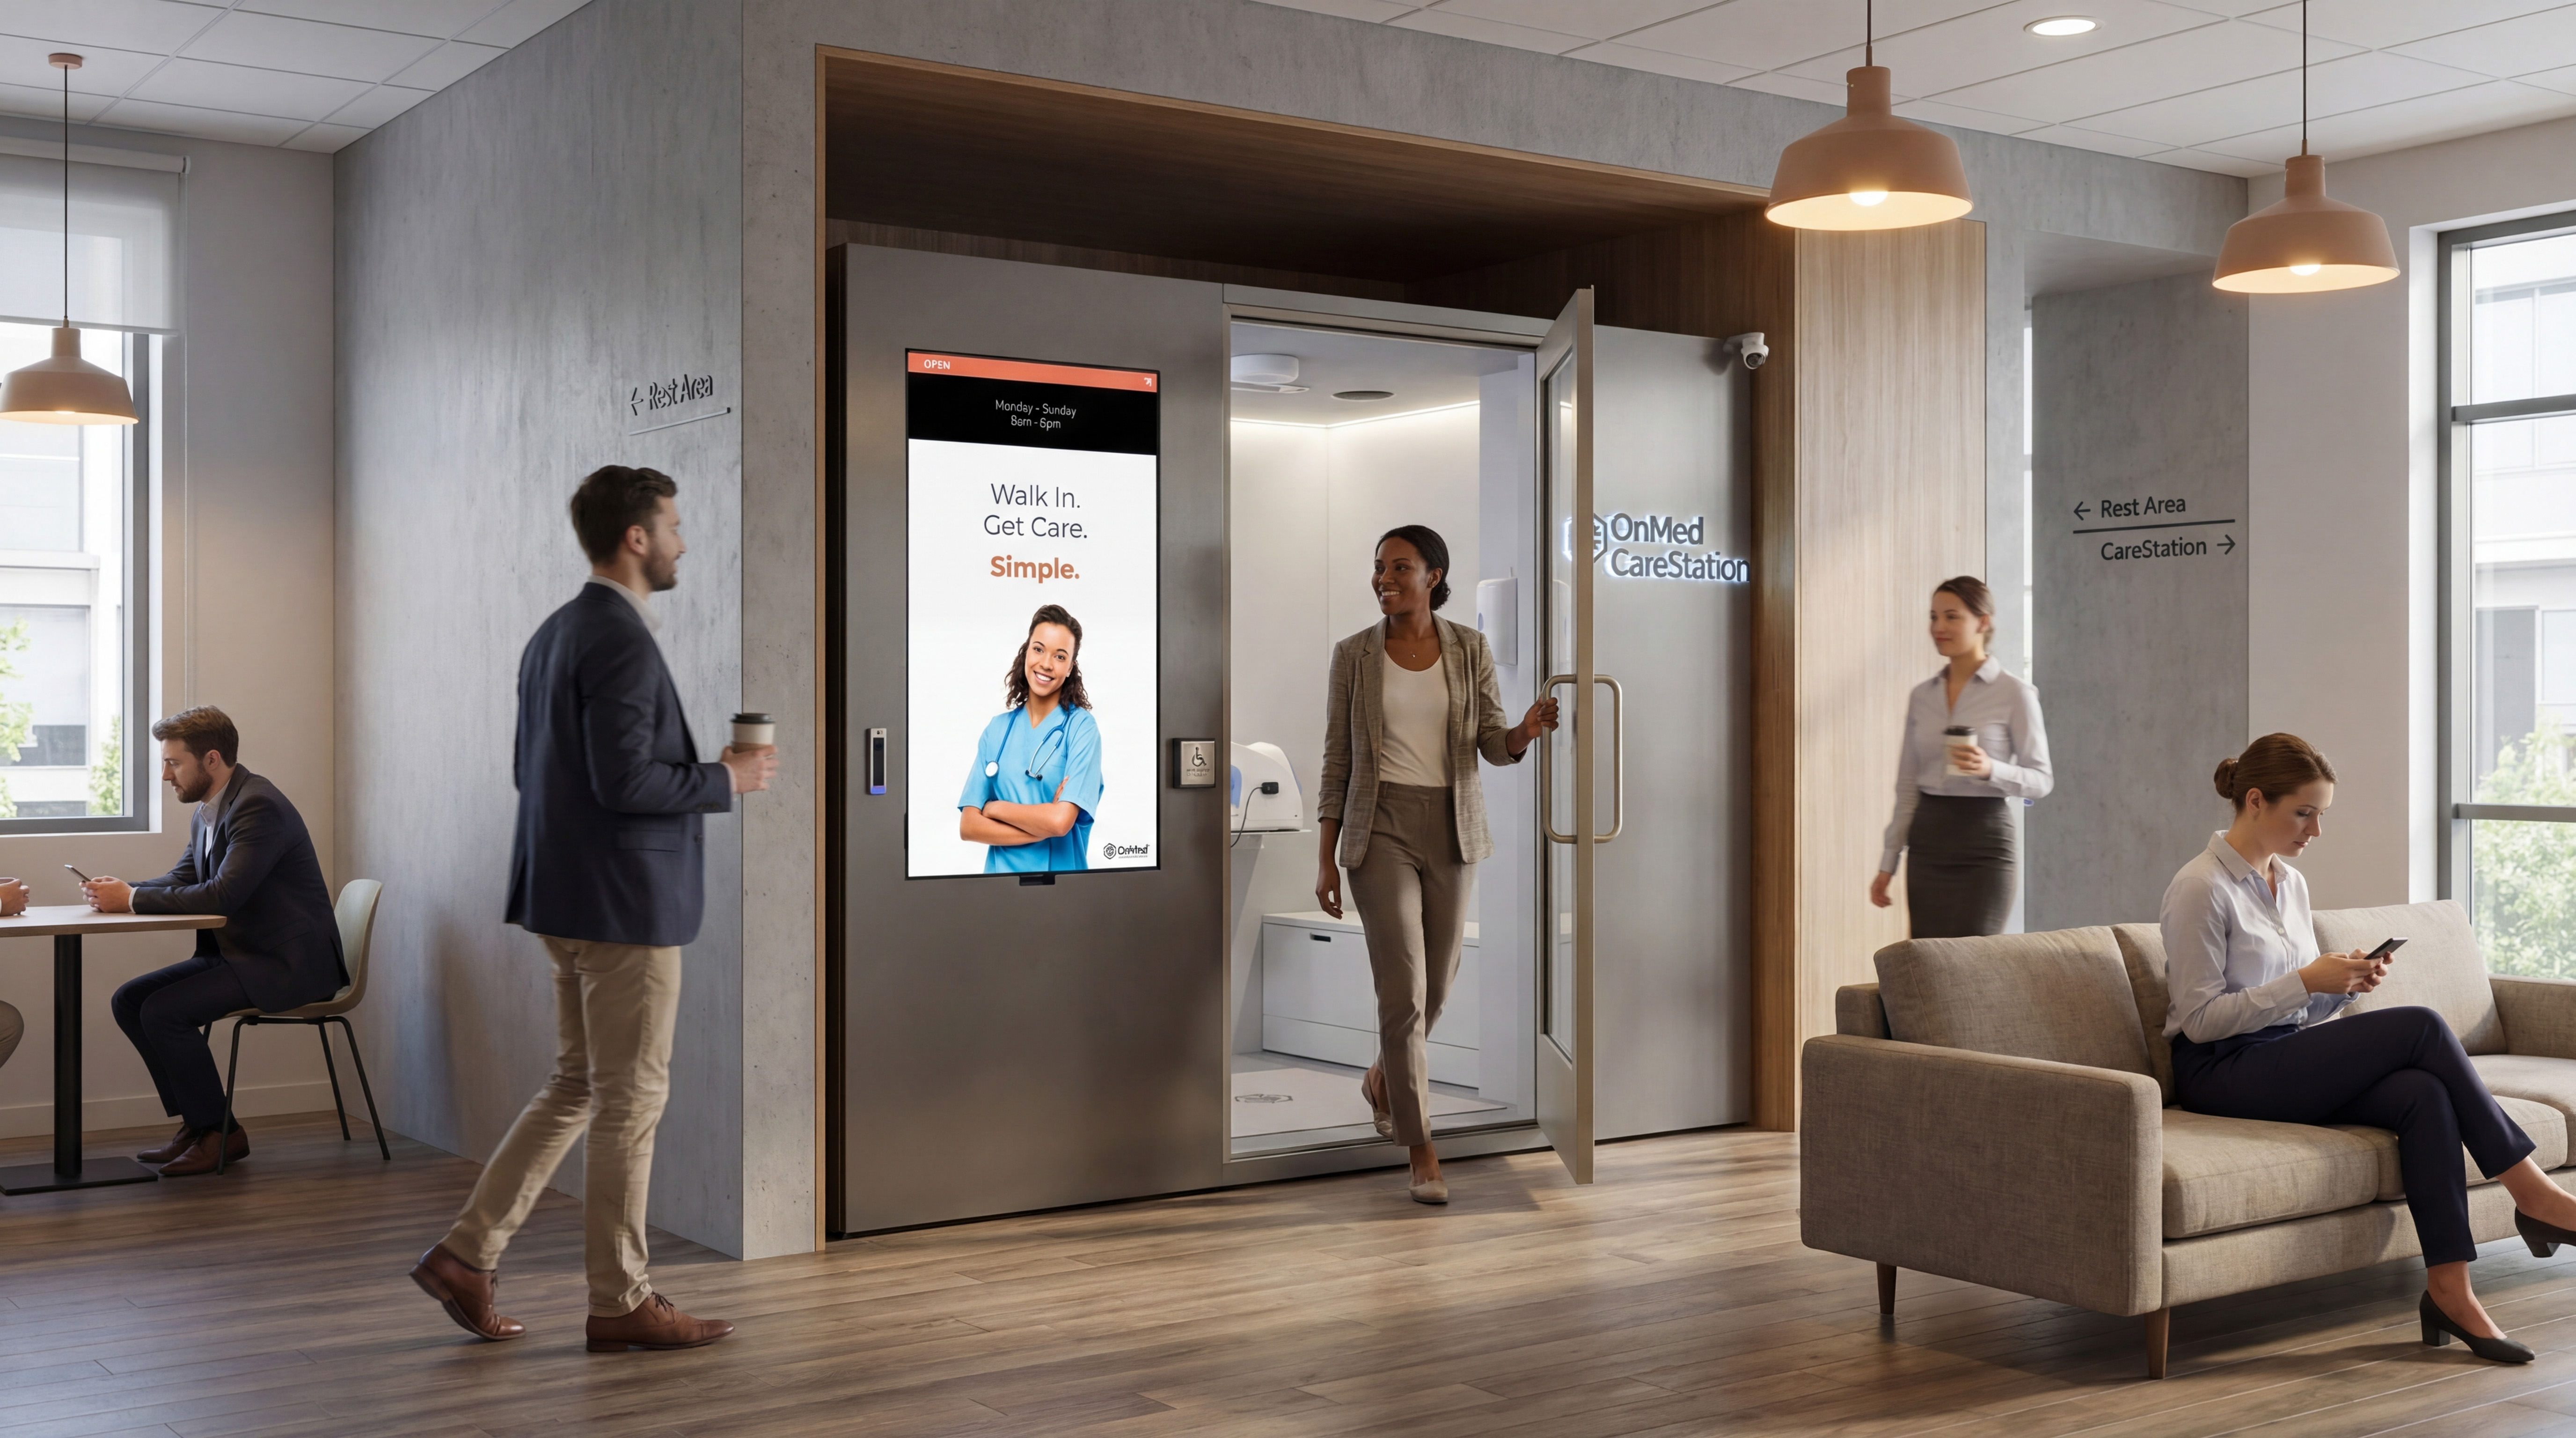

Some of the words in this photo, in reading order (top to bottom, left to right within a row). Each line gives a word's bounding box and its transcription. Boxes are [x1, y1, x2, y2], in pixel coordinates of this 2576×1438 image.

[923, 359, 951, 370] OPEN
[650, 378, 678, 410] Rest
[680, 374, 713, 403] Area
[995, 399, 1033, 416] Monday
[1042, 403, 1076, 419] Sunday
[1039, 418, 1061, 432] 6pm
[990, 483, 1048, 507] Walk
[1056, 486, 1080, 508] In.
[2101, 499, 2140, 518] Rest
[2144, 496, 2186, 515] Area
[984, 514, 1025, 536] Get
[1032, 516, 1088, 539] Care.
[1610, 513, 1704, 545] OnMed
[2101, 537, 2207, 560] CareStation
[990, 554, 1080, 584] Simple.
[1611, 548, 1750, 582] CareStation
